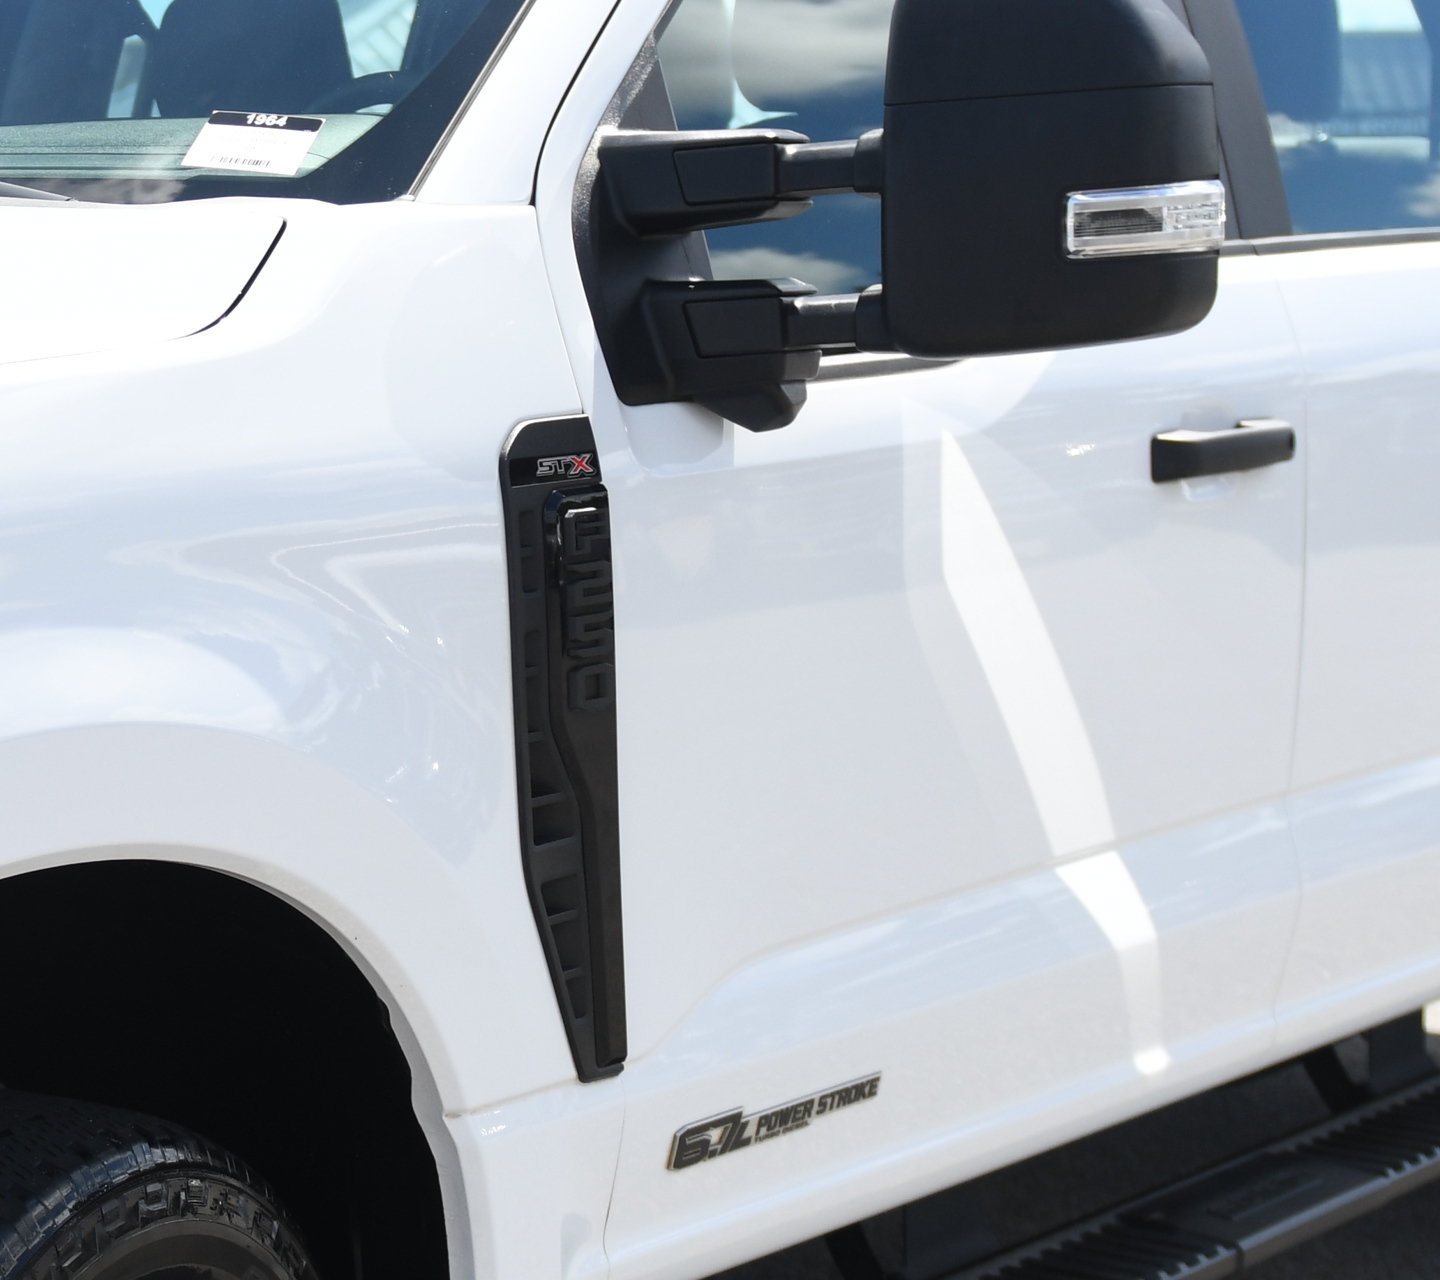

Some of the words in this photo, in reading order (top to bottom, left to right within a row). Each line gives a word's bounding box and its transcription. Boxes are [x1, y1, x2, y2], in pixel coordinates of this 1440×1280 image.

[246, 112, 289, 127] 1964
[536, 453, 597, 477] STX
[669, 1108, 753, 1171] 6.7L
[755, 1098, 816, 1137] POWER
[816, 1076, 881, 1116] STROKE
